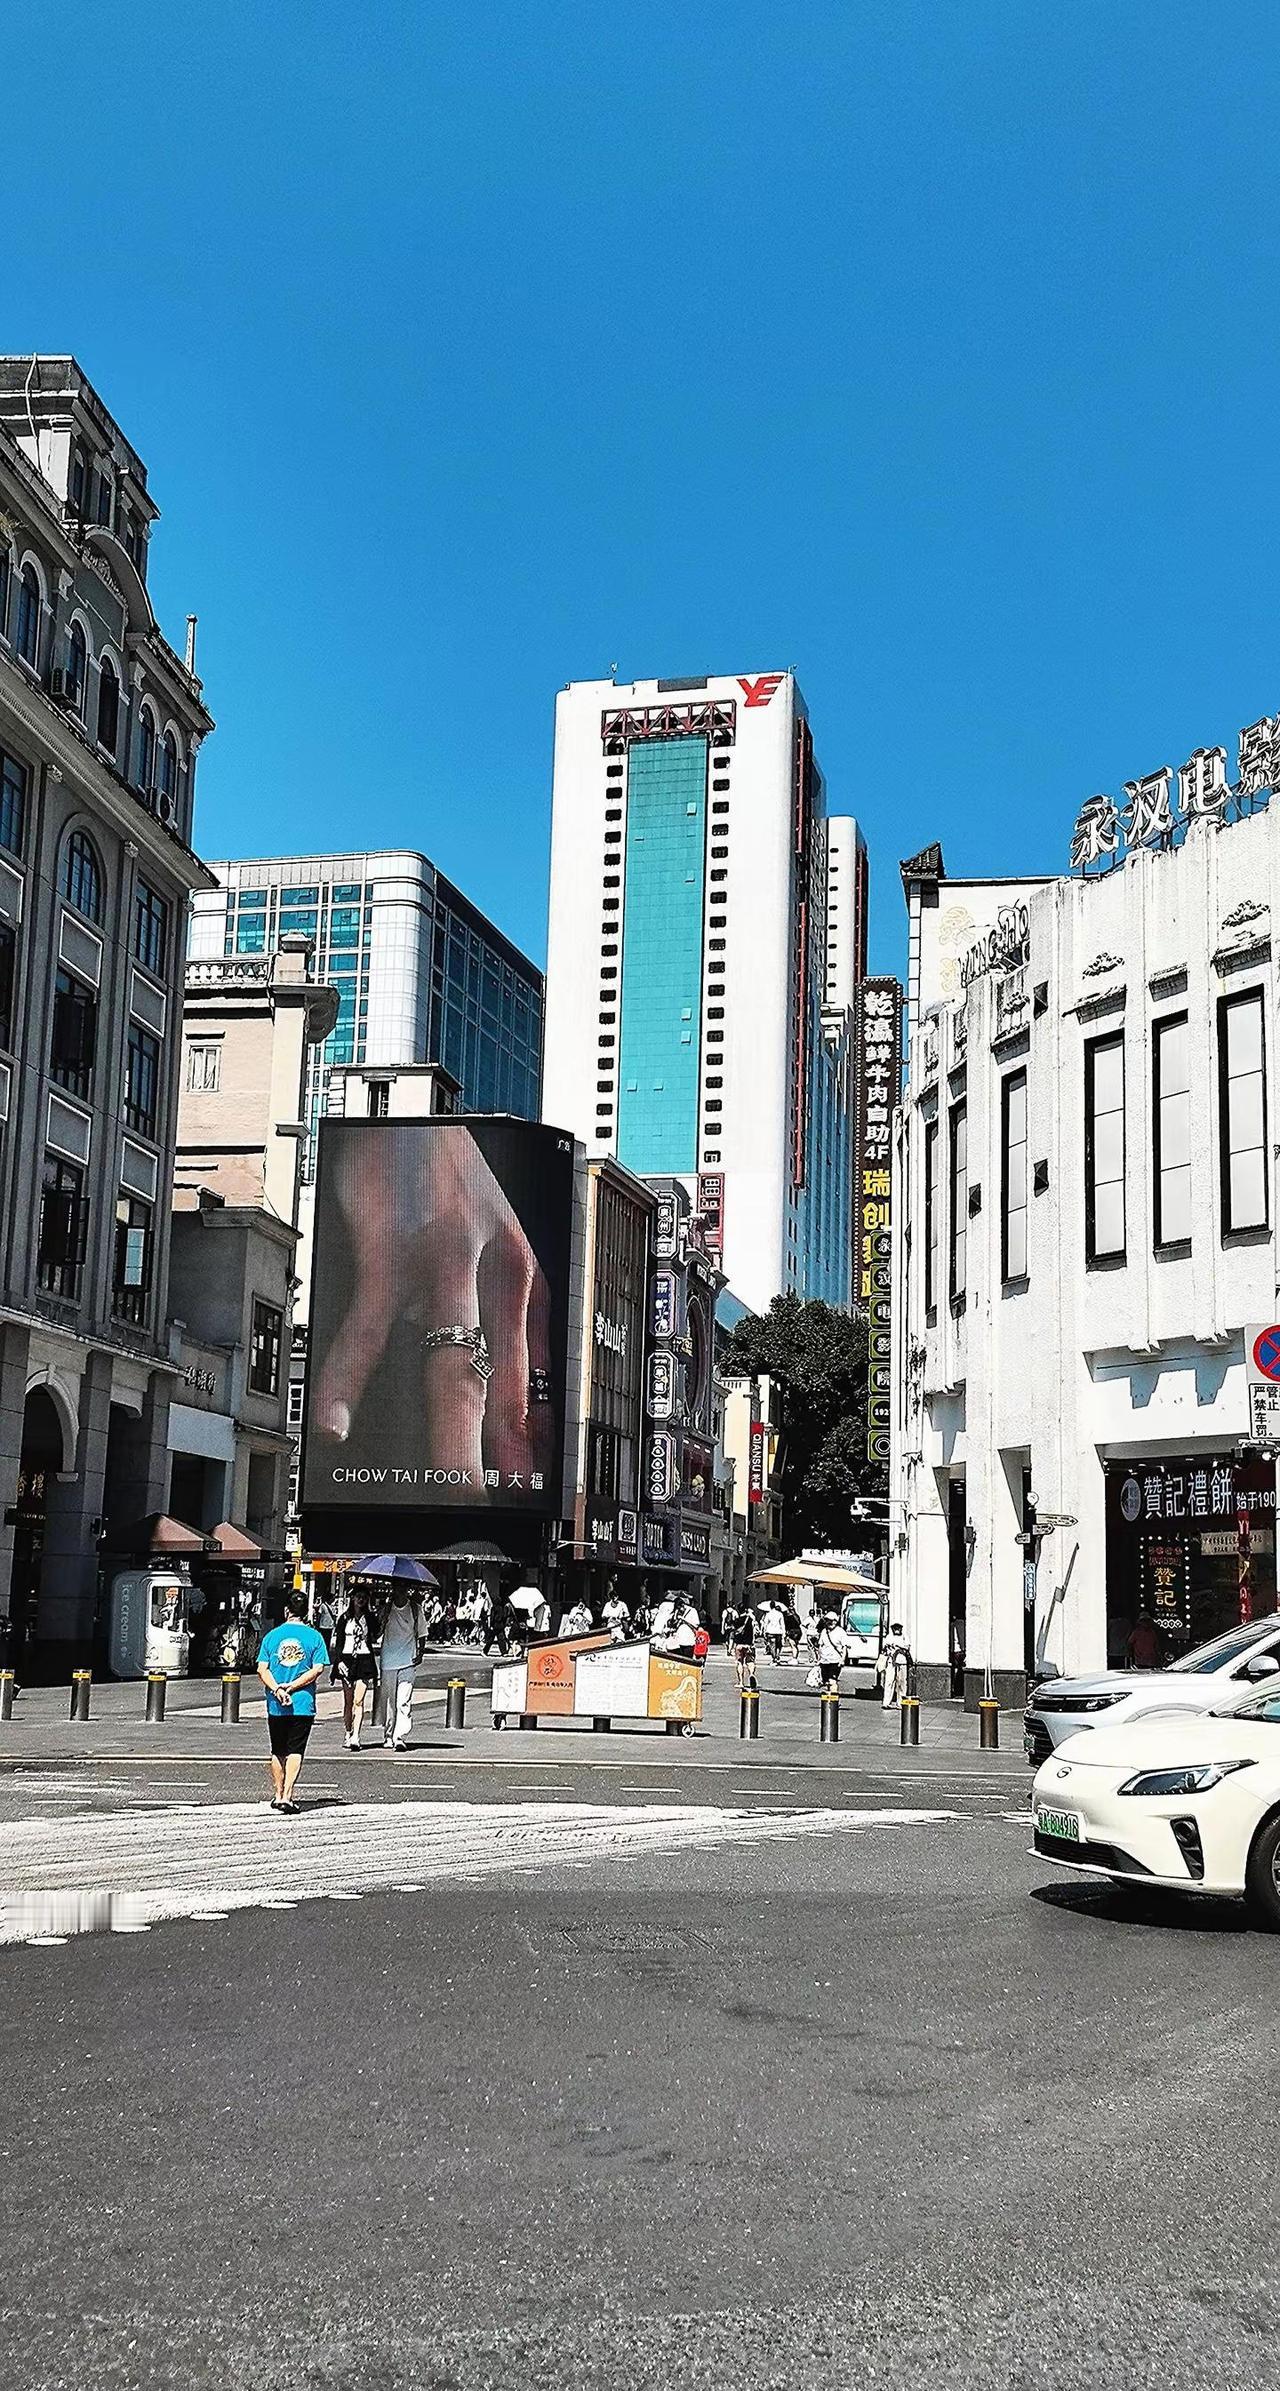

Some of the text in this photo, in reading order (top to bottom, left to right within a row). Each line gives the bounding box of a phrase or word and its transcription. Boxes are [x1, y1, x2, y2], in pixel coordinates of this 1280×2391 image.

[1253, 1386, 1280, 1398] 严管
[752, 1433, 762, 1472] QIANSU
[332, 1468, 473, 1485] CHOW TAI FOOK
[483, 1469, 544, 1490] 周大福
[1236, 1490, 1276, 1511] 始于190
[120, 1605, 130, 1643] cream
